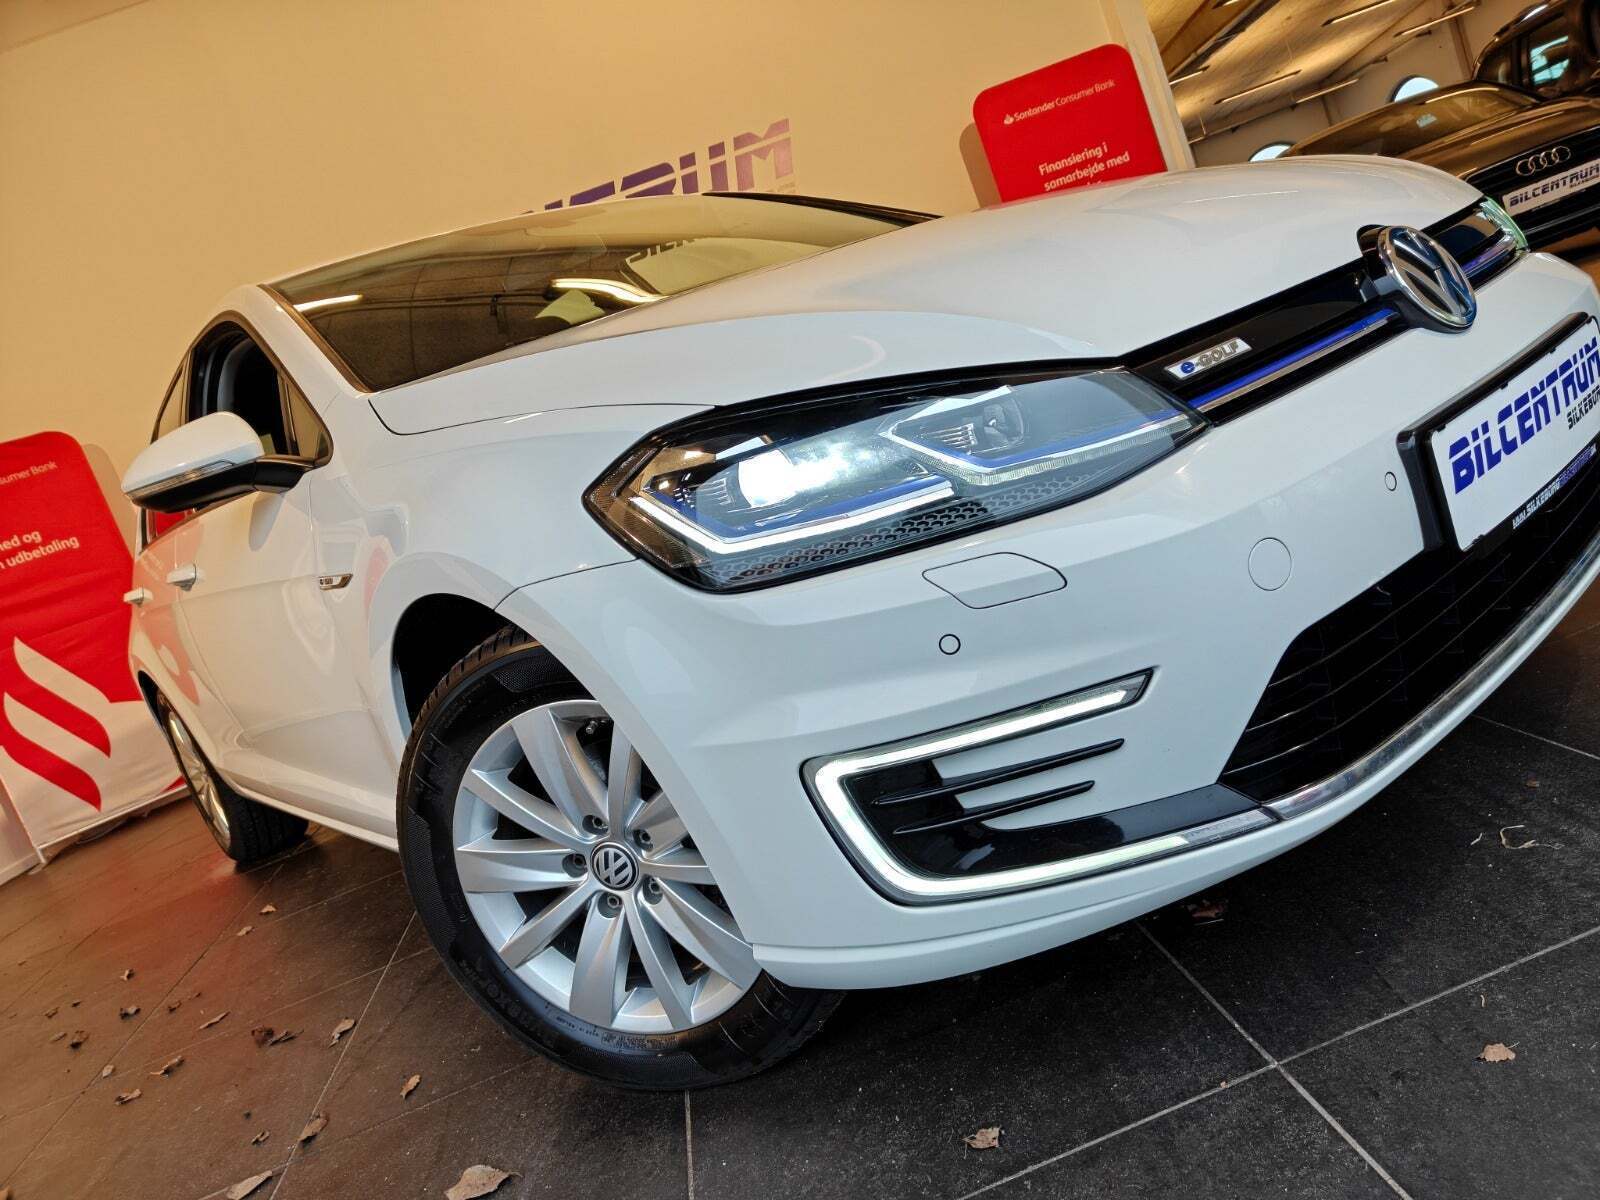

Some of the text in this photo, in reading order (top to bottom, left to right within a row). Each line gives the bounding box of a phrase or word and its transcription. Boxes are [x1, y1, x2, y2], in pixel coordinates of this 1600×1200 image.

[1013, 79, 1116, 122] Santander Consumer Bank
[1038, 141, 1109, 176] Finansiering i
[1044, 150, 1131, 192] samarbejde med
[1449, 336, 1600, 495] BILCENTRUM
[30, 461, 58, 476] Bank
[5, 536, 80, 568] udbetaling
[22, 531, 42, 544] og
